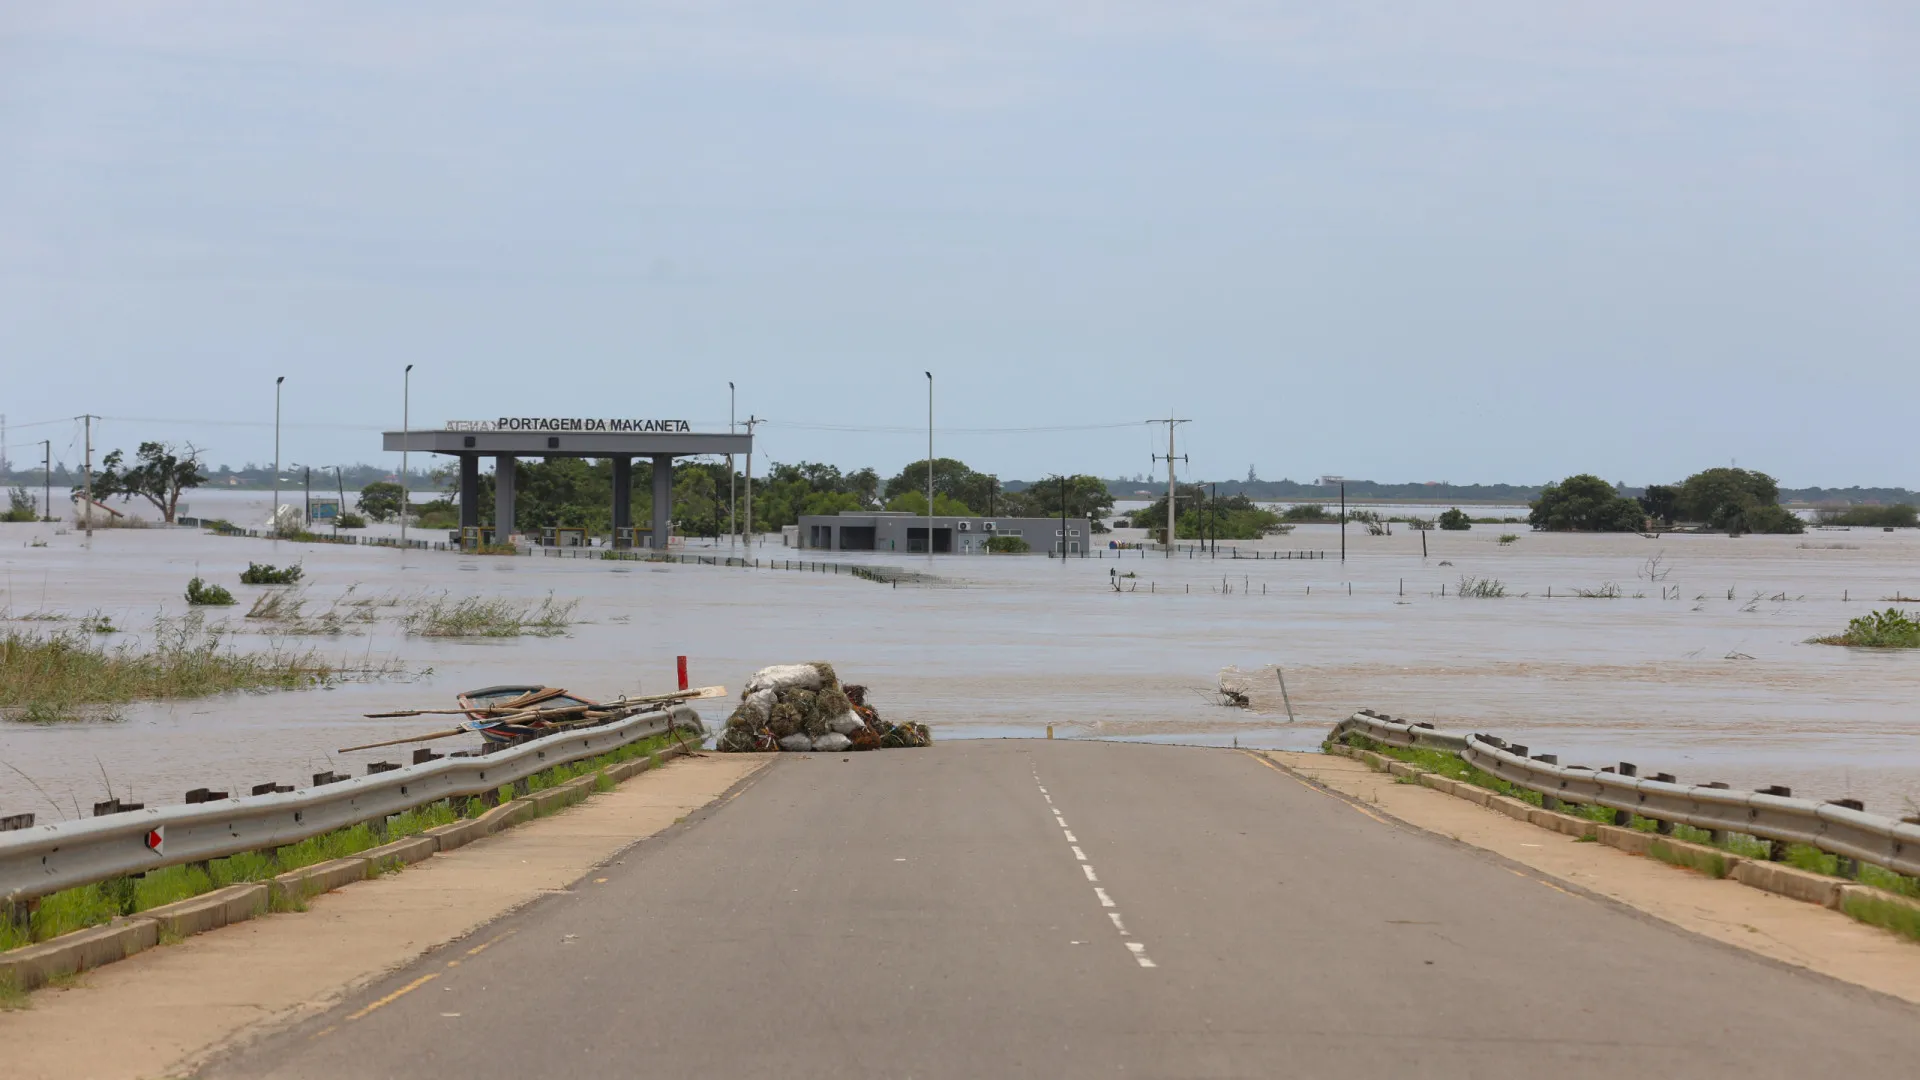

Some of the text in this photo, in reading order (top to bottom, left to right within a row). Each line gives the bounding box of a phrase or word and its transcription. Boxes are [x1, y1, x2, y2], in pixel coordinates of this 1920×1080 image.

[499, 418, 690, 432] PORTAGEM DA MAKANETA
